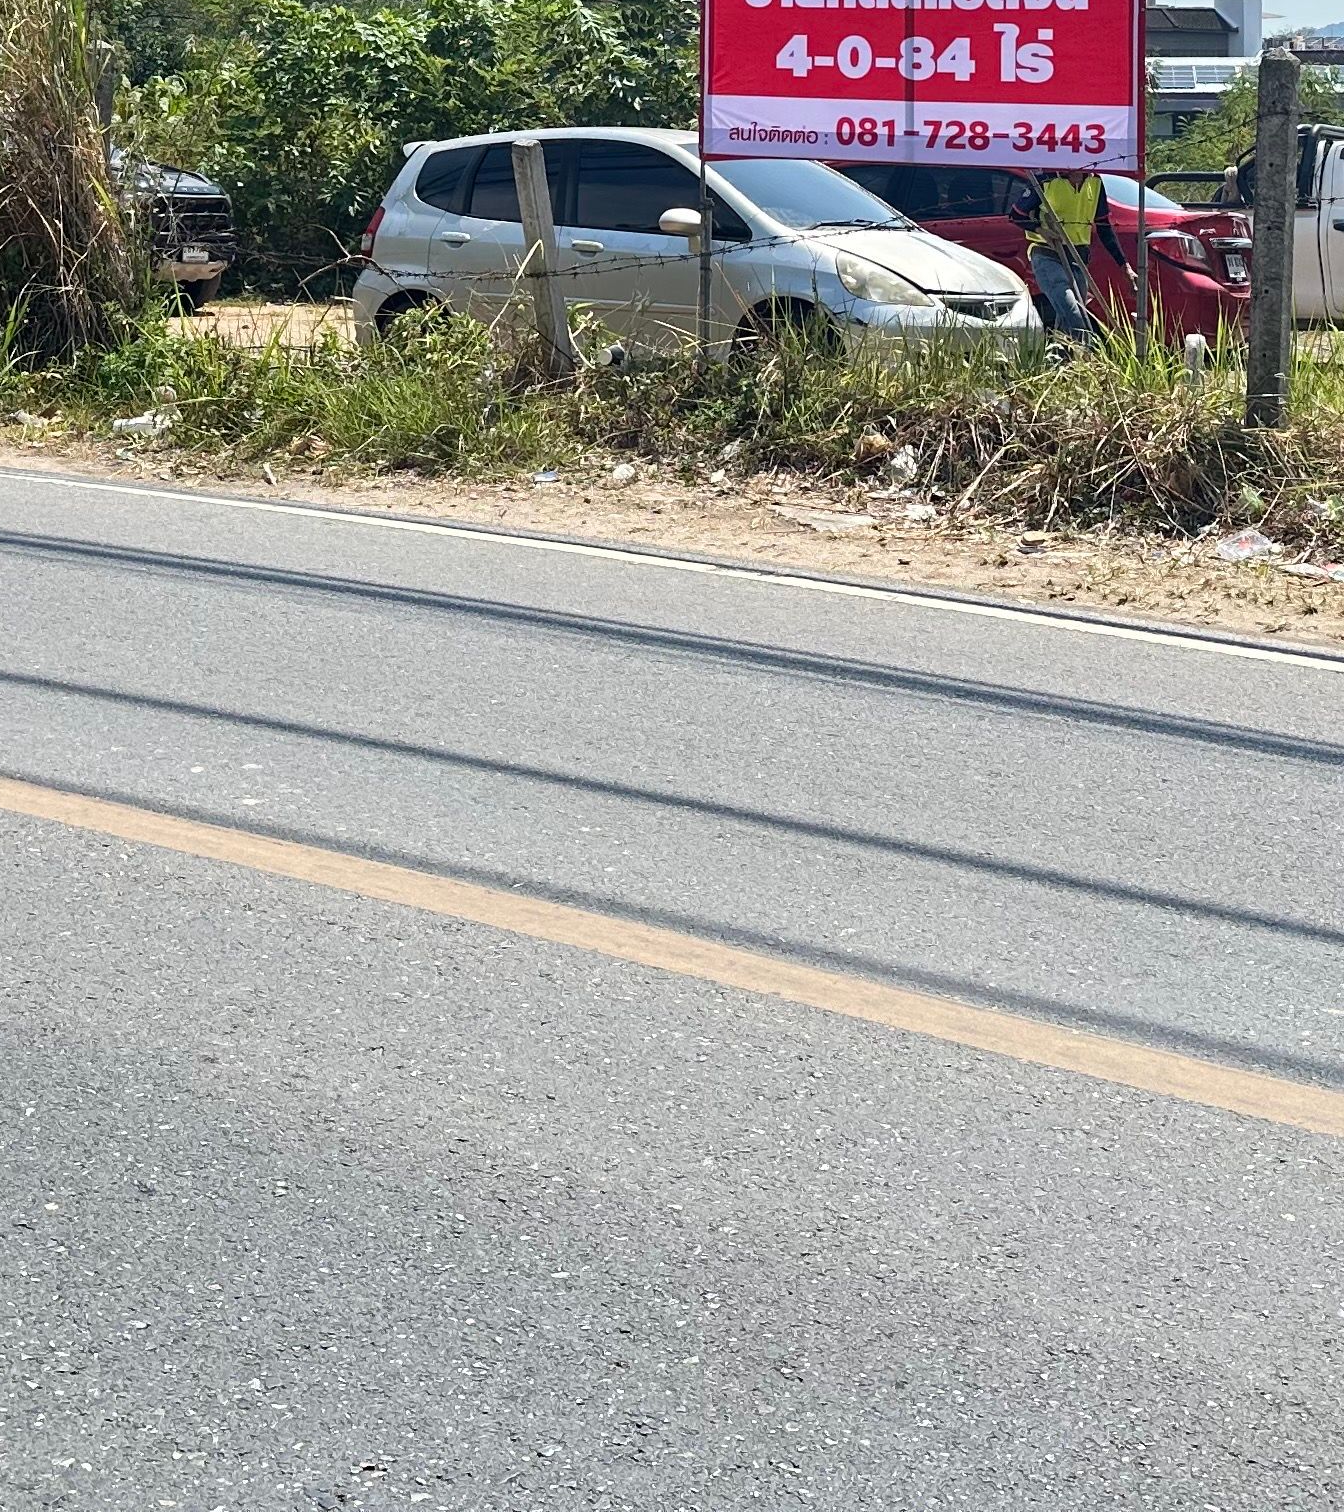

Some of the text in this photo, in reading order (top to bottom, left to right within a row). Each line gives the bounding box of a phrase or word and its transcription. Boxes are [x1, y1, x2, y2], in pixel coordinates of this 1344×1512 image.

[775, 22, 1055, 83] 4-0-84 ไร่
[729, 121, 819, 145] สนใจติดต่อ
[835, 116, 1106, 154] 081-728-3443
